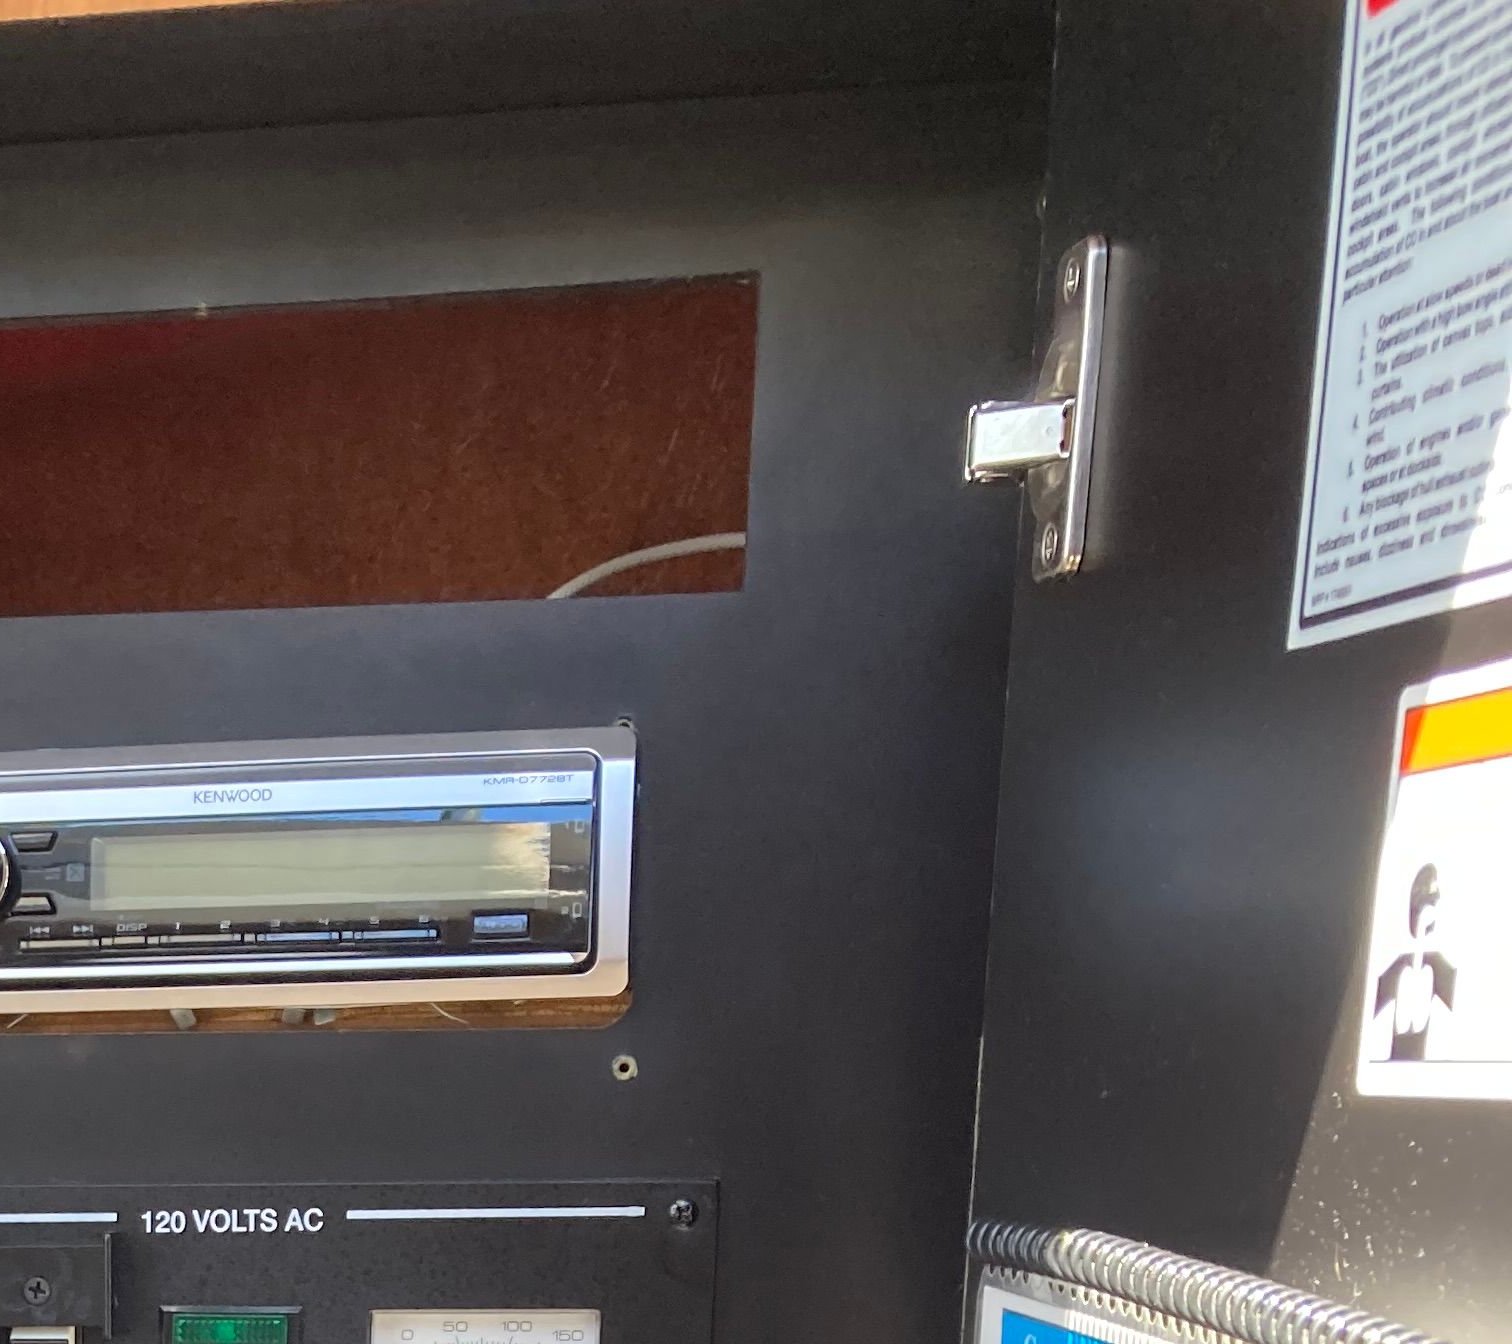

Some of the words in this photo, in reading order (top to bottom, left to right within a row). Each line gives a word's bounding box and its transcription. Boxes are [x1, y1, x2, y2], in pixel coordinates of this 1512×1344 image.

[192, 786, 273, 805] KENWOOD
[116, 922, 147, 933] DISP
[140, 1209, 186, 1235] 120
[192, 1208, 278, 1234] VOLTS
[284, 1207, 324, 1232] AC
[442, 1321, 468, 1332] 50
[502, 1321, 533, 1332] 100
[552, 1330, 584, 1342] 150
